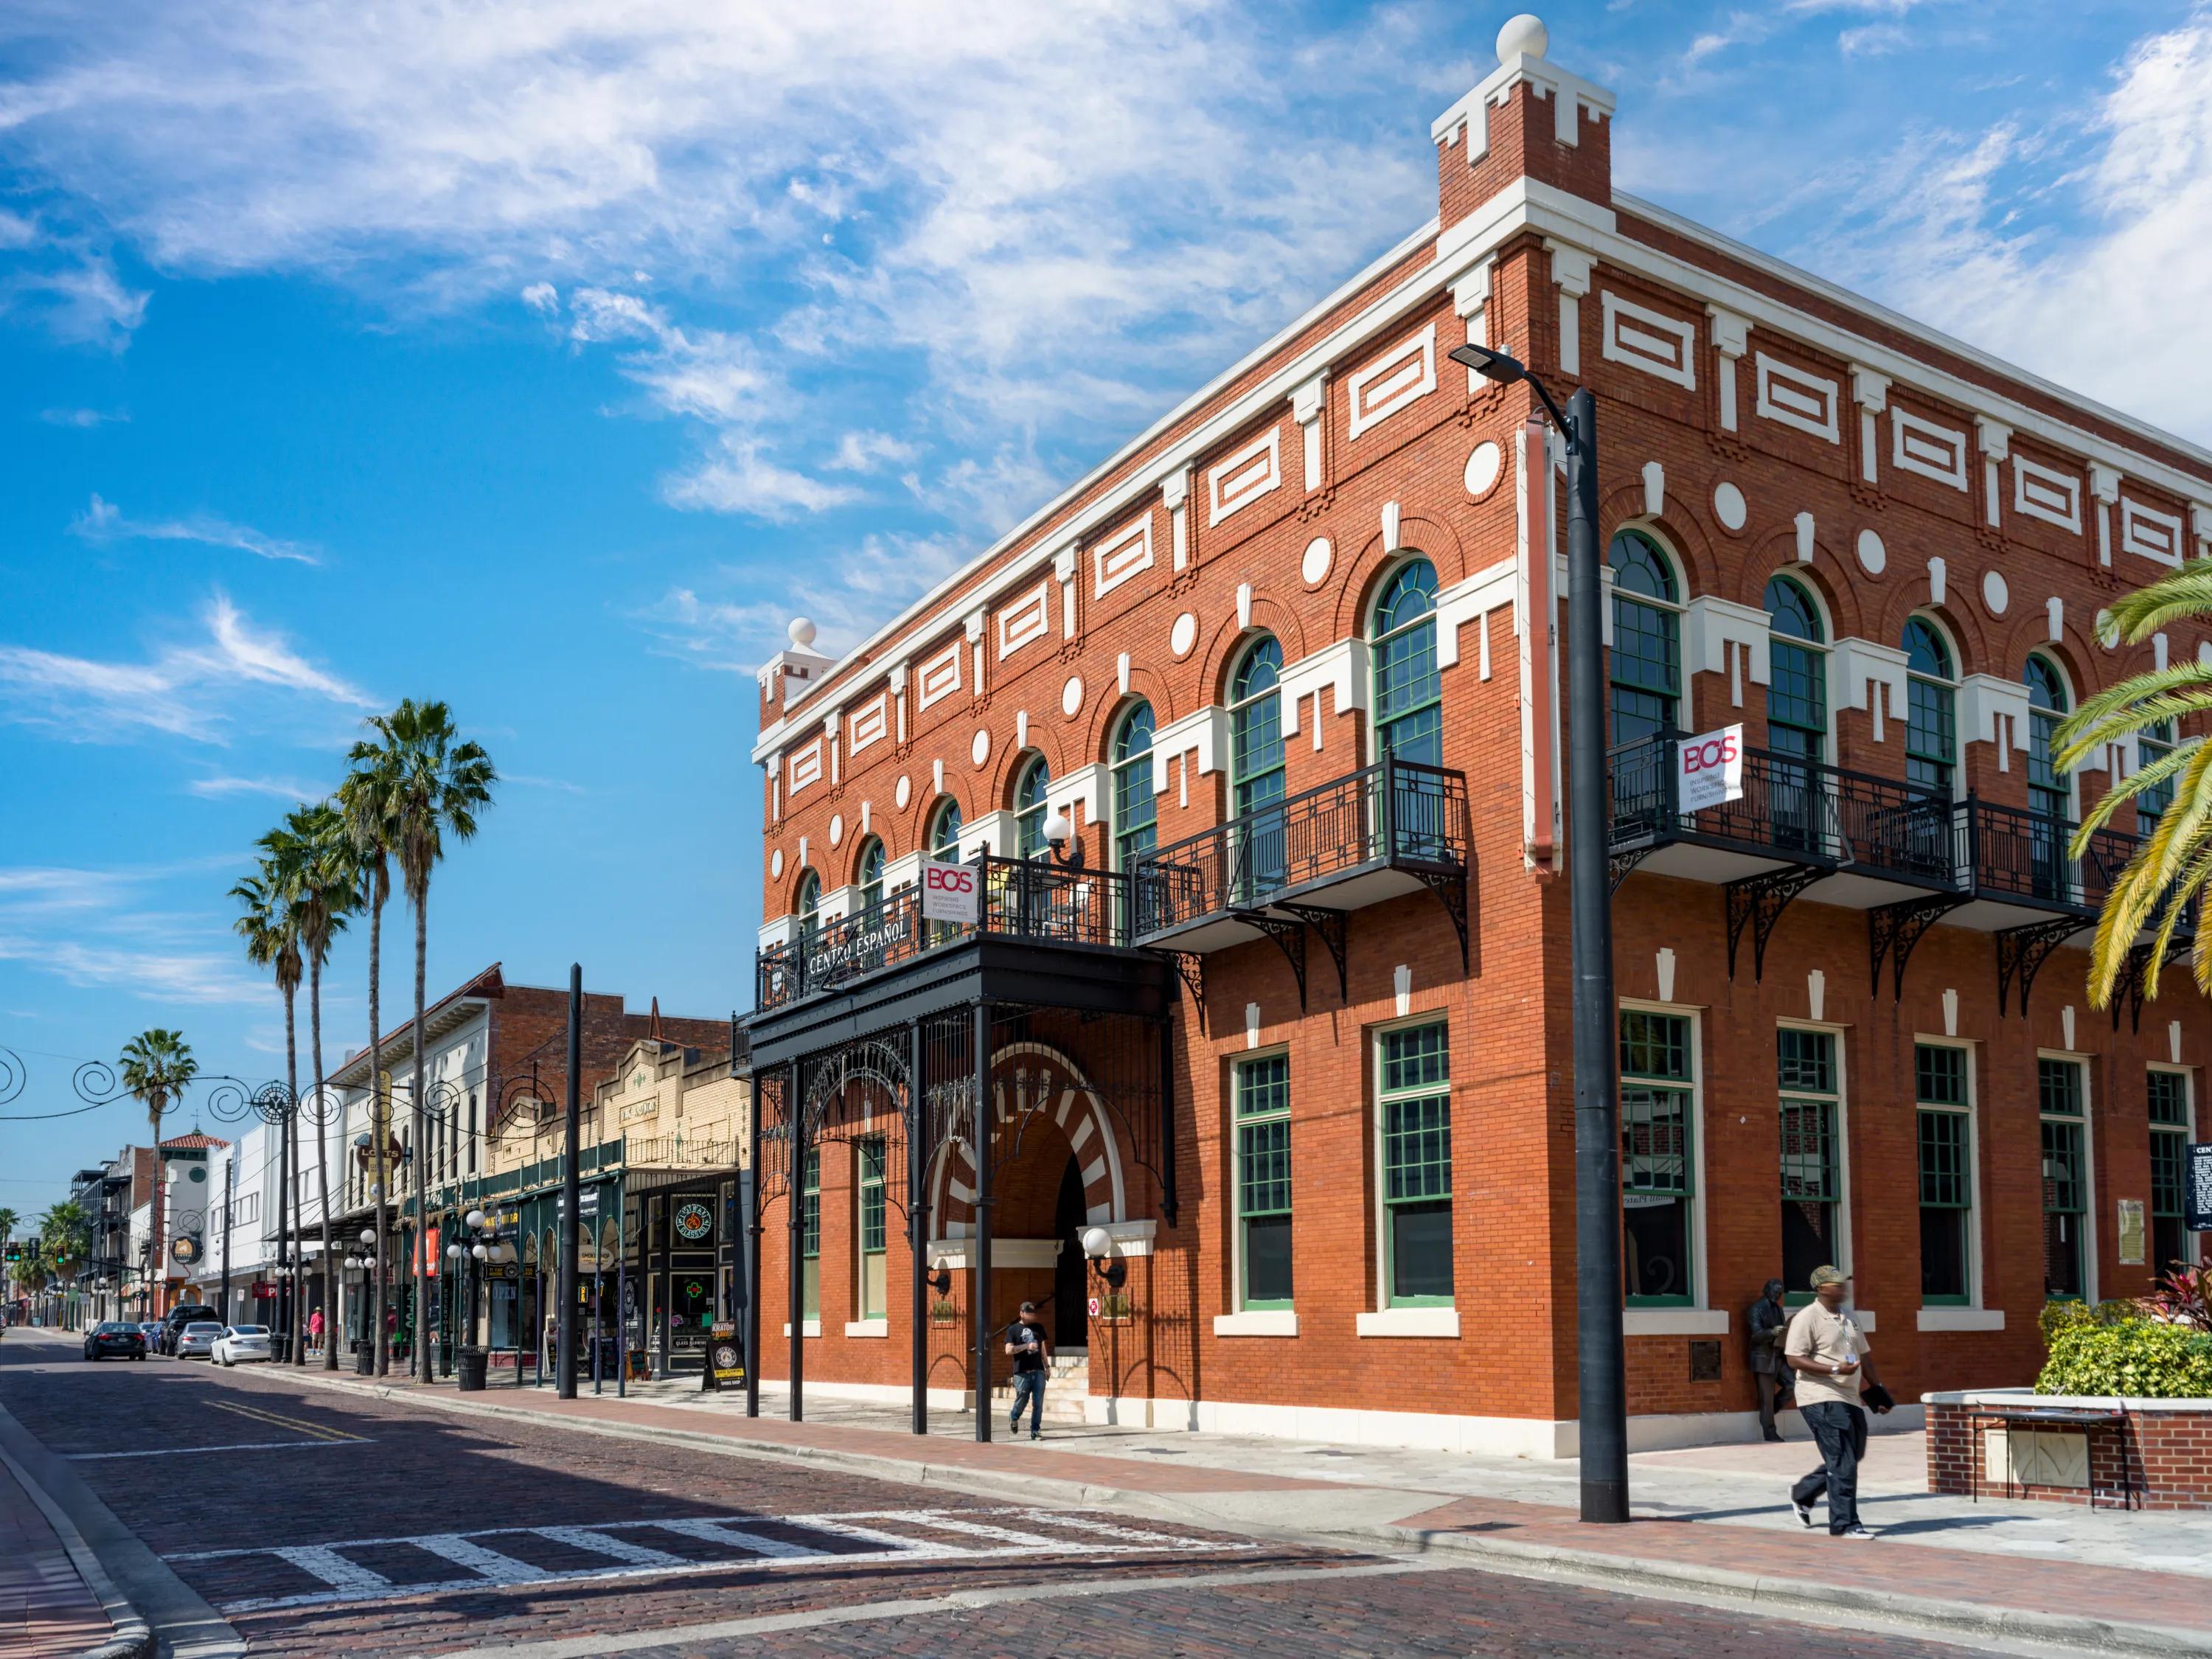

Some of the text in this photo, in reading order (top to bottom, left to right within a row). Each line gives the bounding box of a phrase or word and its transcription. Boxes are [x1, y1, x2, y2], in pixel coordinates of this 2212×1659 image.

[1683, 735, 1737, 775] BOS
[1690, 773, 1720, 786] INSPIRING
[927, 867, 973, 894] BOS
[810, 920, 907, 974] CENTRO ESPAÑOL
[361, 1149, 399, 1158] LOTS
[2197, 1145, 2212, 1154] CEN
[493, 1286, 517, 1299] OPEN
[712, 1324, 734, 1332] KRATOM
